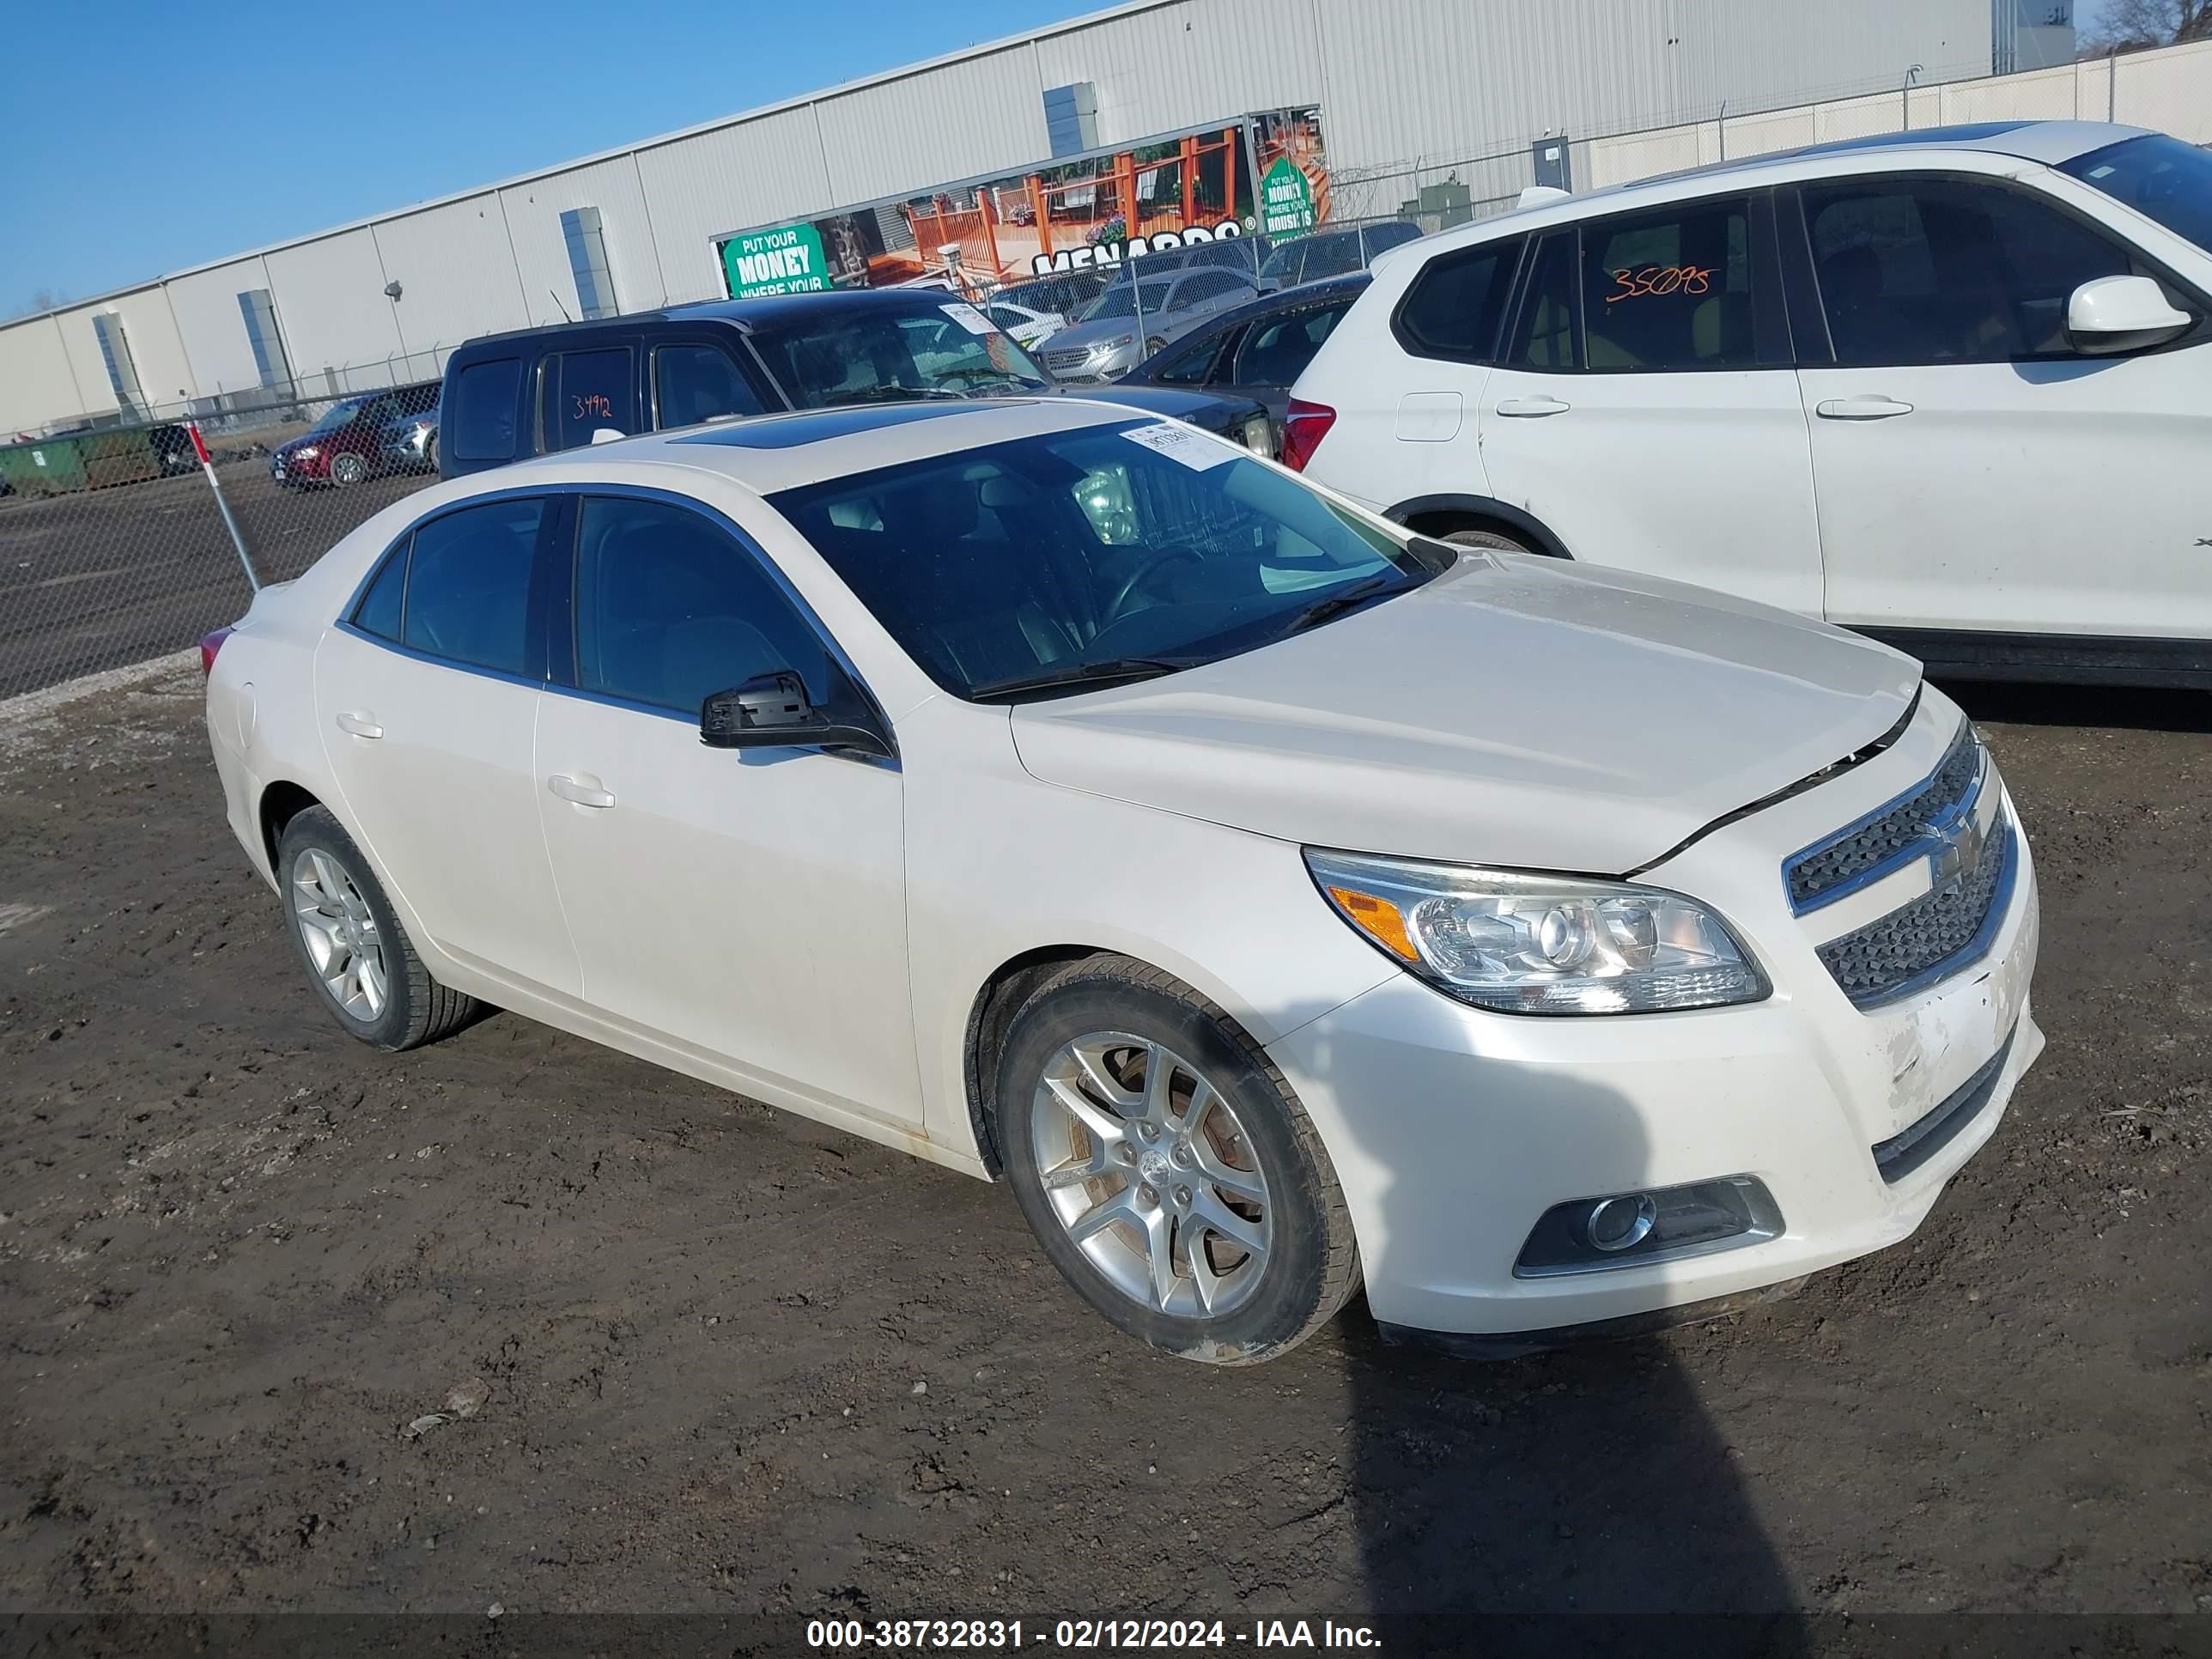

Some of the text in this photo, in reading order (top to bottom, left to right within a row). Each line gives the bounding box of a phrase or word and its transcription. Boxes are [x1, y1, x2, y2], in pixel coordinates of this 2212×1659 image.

[742, 230, 798, 254] PUT YOUR
[736, 244, 811, 285] MONEY
[1606, 266, 1721, 302] 35095
[571, 394, 612, 420] 34912
